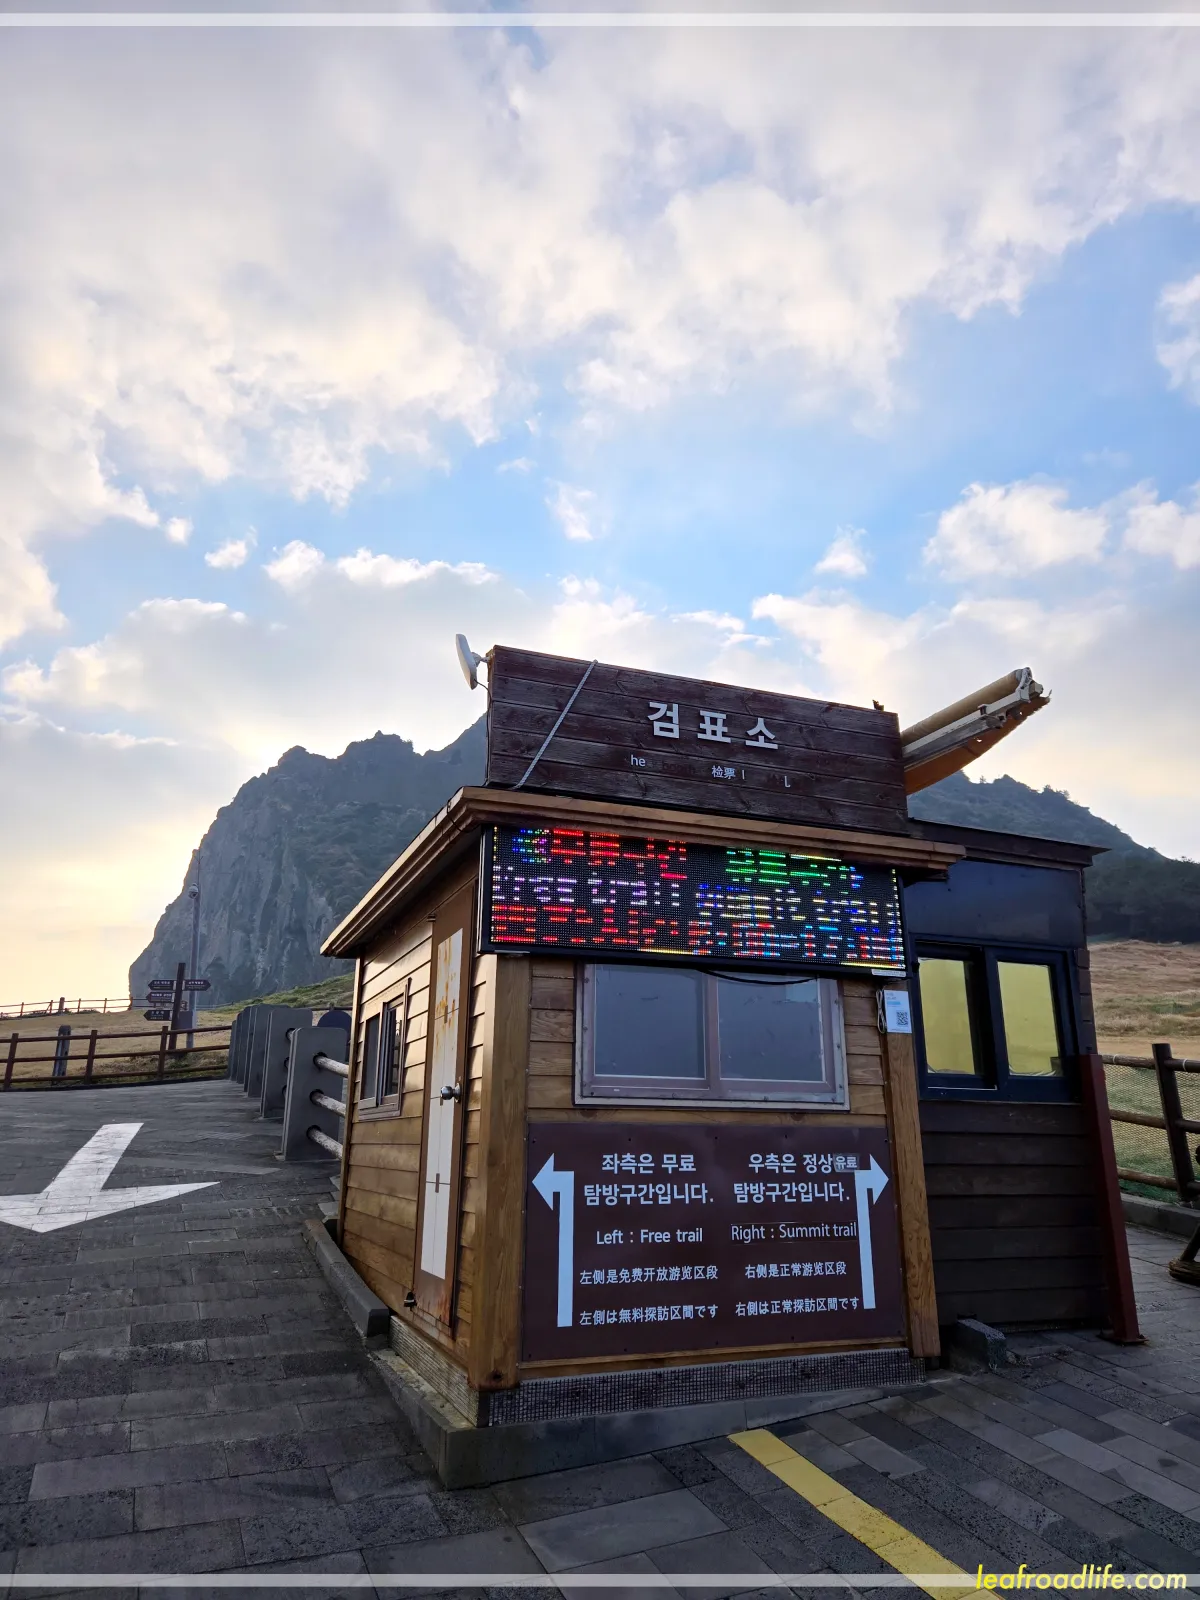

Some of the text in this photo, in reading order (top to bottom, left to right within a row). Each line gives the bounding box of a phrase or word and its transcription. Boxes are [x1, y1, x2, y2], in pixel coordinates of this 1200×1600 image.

[602, 1153, 697, 1174] 좌측은 무료
[748, 1153, 797, 1174] 우측은
[584, 1183, 714, 1206] 탐방구간입니다.
[733, 1181, 850, 1203] 탐방구간입니다.
[596, 1229, 624, 1245] Left
[640, 1229, 671, 1243] Free
[676, 1227, 703, 1242] trail
[731, 1224, 766, 1244] Right
[779, 1223, 830, 1238] Summit
[833, 1221, 857, 1237] trail
